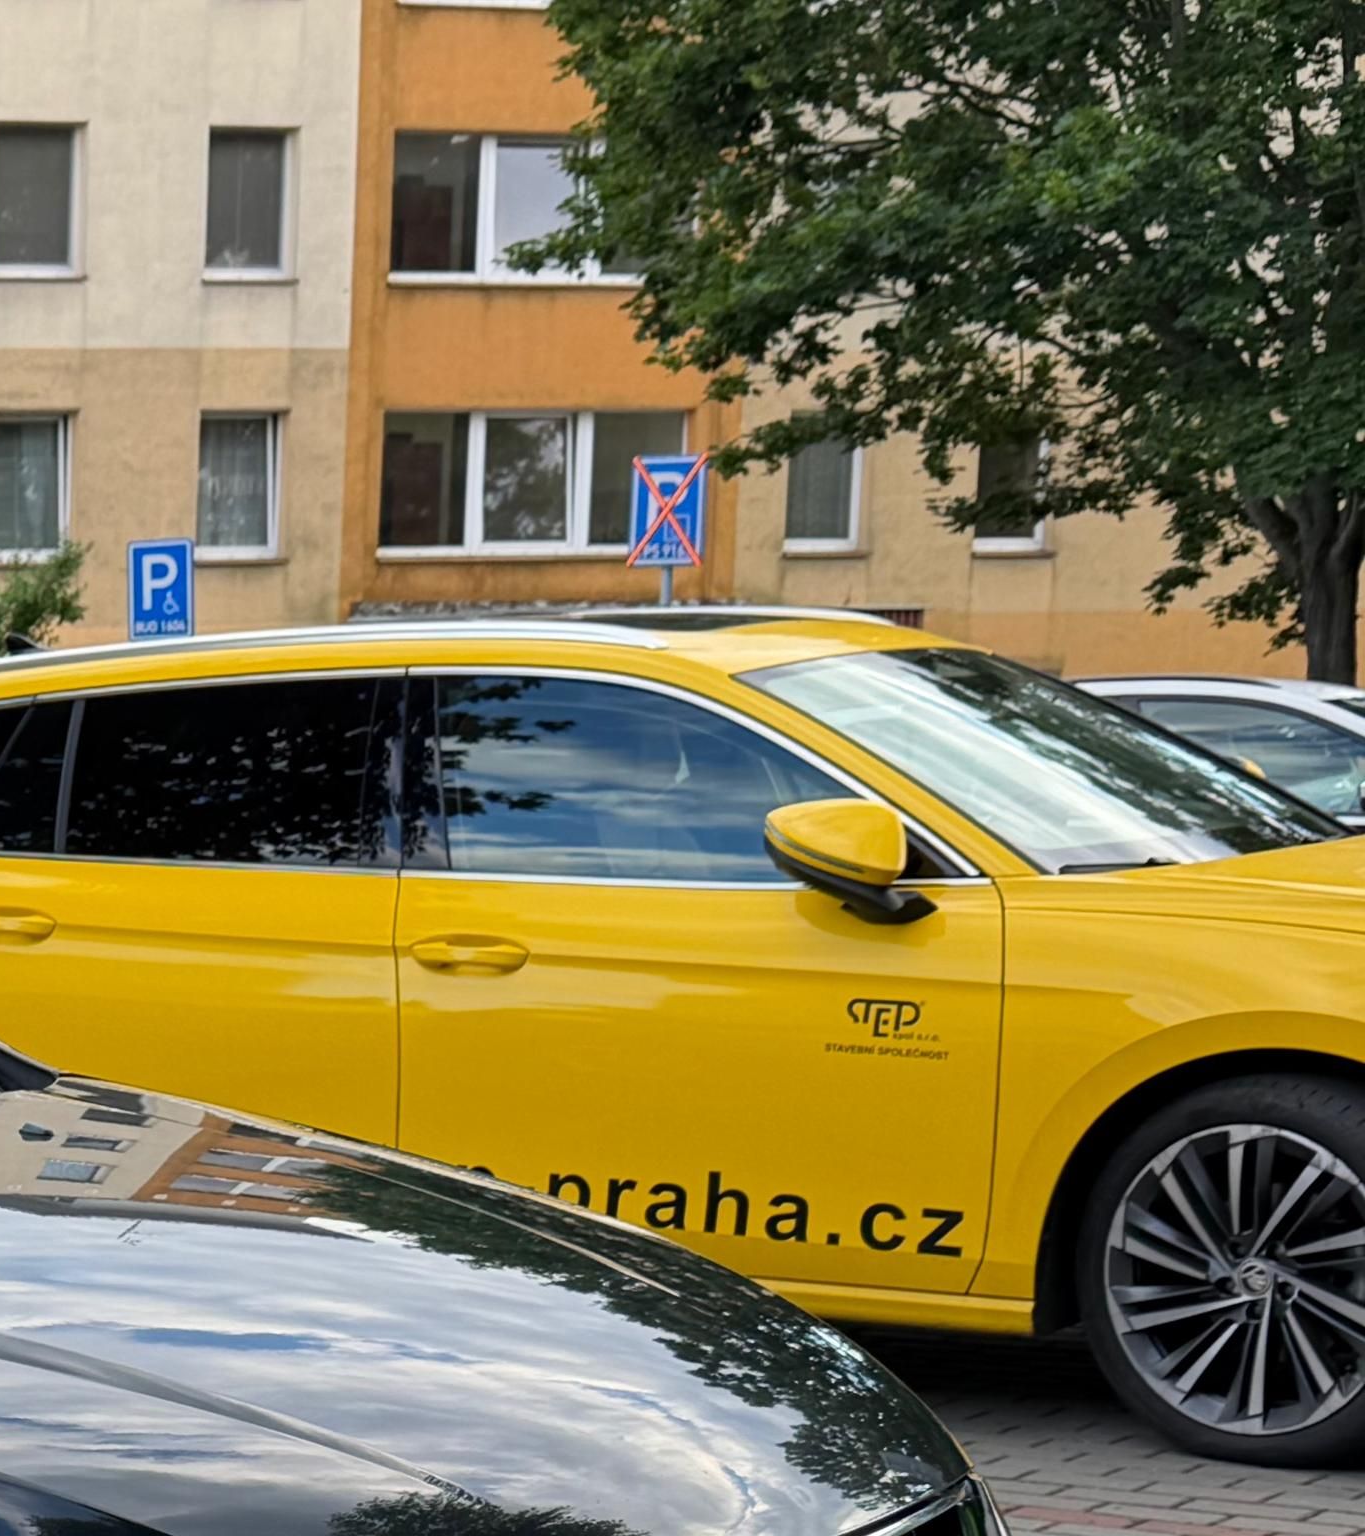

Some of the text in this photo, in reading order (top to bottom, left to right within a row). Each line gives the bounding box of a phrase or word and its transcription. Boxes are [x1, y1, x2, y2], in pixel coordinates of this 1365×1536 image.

[141, 553, 178, 612] P
[846, 998, 921, 1038] STEP
[824, 1042, 950, 1061] STAVEBNÍ SPOLEČNOST
